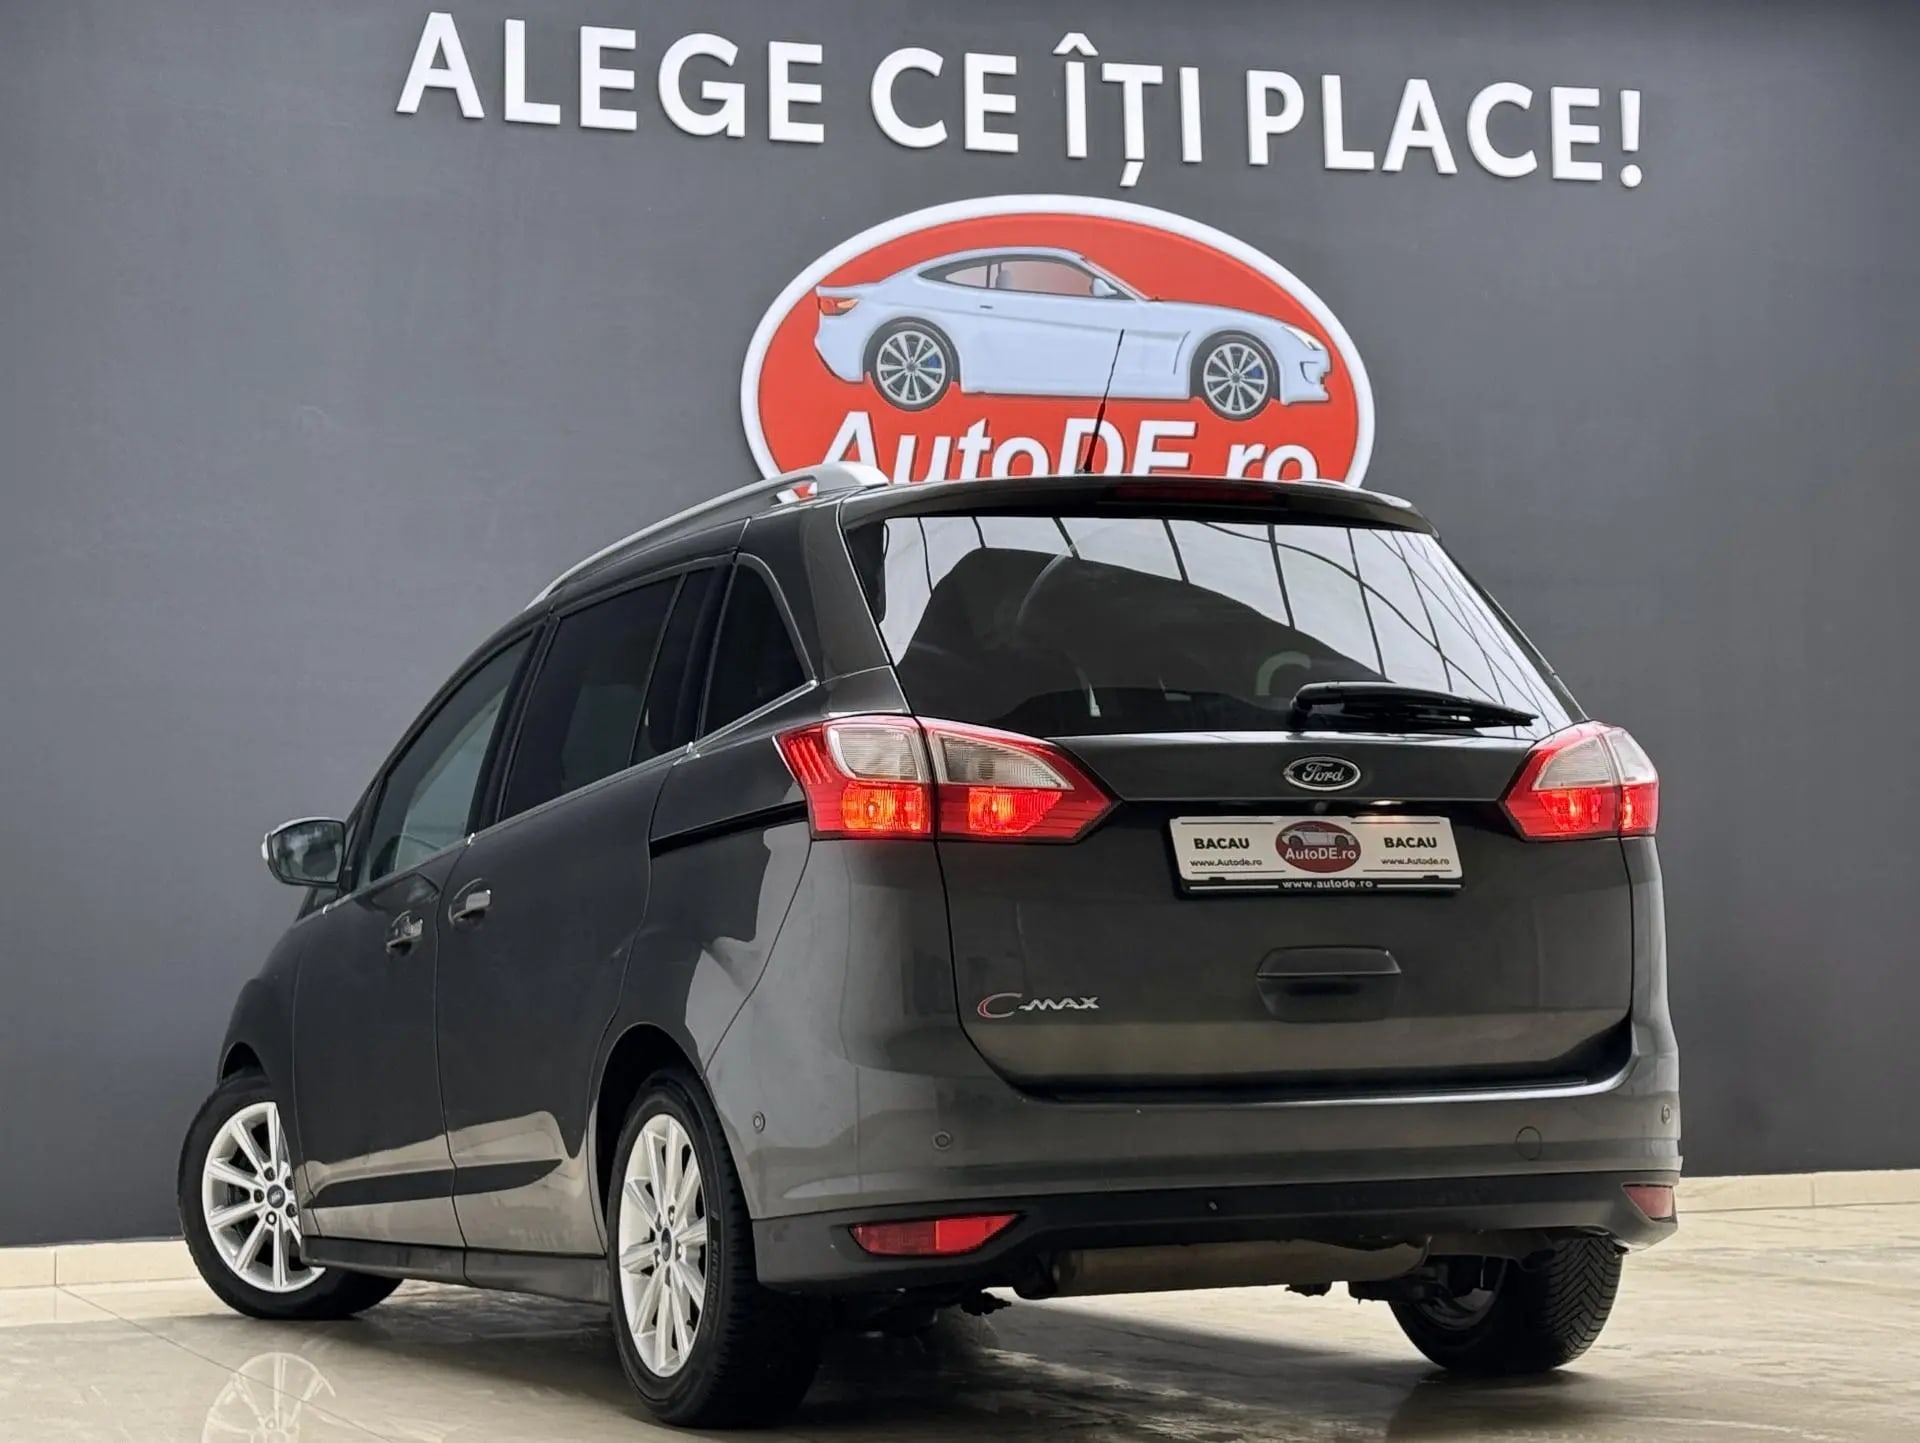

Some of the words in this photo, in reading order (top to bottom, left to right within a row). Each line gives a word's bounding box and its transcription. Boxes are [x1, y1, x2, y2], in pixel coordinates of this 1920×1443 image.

[396, 12, 825, 144] ALEGE
[870, 47, 1019, 153] CE
[1246, 70, 1643, 188] PLACE!
[820, 411, 1319, 484] AutoDEro
[1302, 762, 1345, 782] Ford
[1193, 837, 1250, 850] BACAU
[1384, 836, 1437, 849] BACAU
[1285, 847, 1357, 861] AutoDE.ro
[1282, 878, 1374, 889] www.autode.ro
